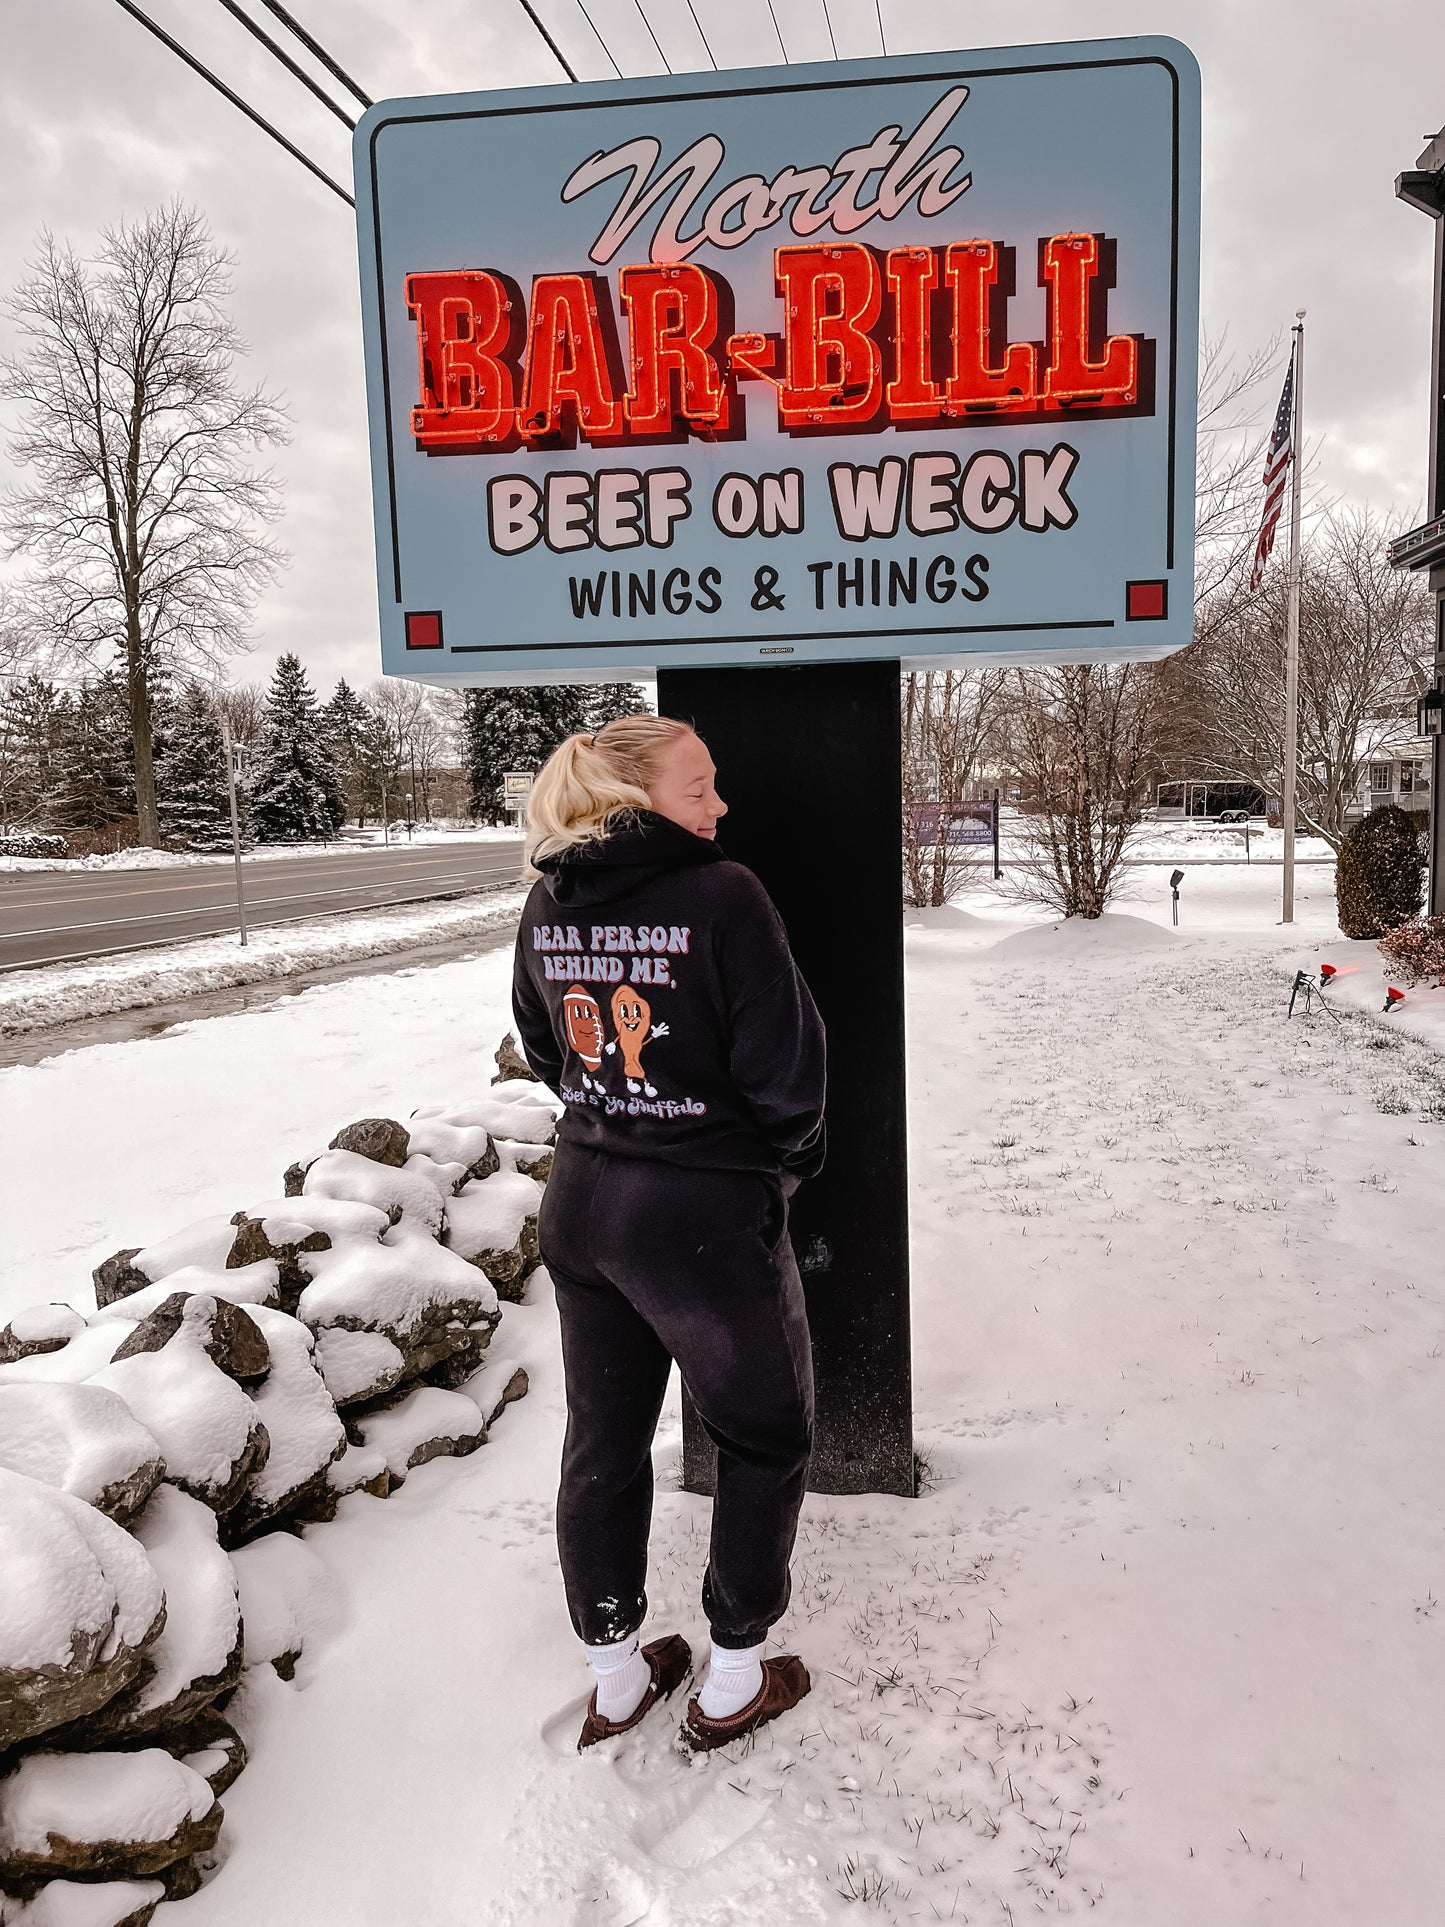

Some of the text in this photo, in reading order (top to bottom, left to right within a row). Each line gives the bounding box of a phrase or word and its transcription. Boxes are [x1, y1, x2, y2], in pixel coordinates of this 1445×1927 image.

[561, 85, 972, 266] North
[403, 231, 1156, 457] BAR-BILL
[487, 442, 1080, 556] BEEF ON WECK
[569, 553, 990, 619] WINGS & THINGS
[533, 925, 691, 954] DEAR PERSON
[543, 956, 624, 983] BEHIND
[560, 1083, 600, 1106] Lets
[626, 1097, 707, 1119] Buffalo
